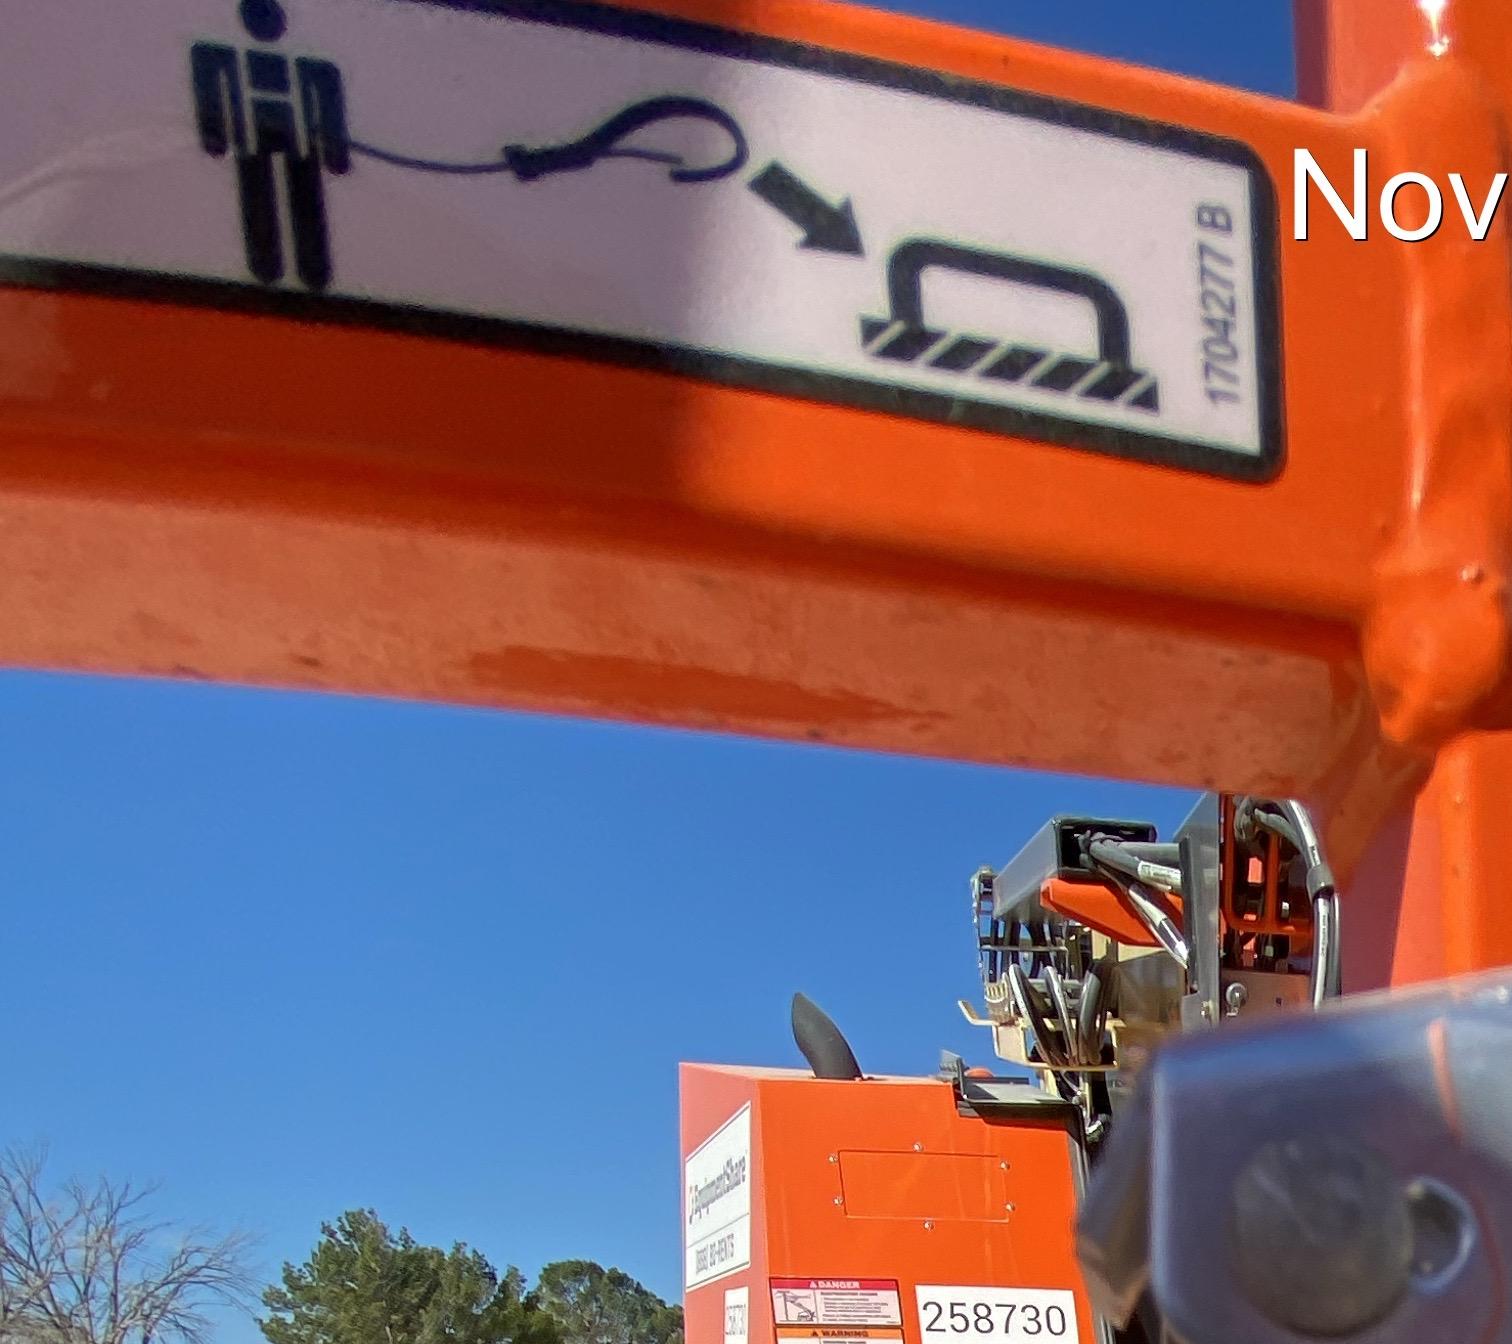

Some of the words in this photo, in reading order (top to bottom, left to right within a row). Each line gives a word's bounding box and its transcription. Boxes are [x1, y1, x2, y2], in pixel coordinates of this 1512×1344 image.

[1197, 205, 1234, 233] B
[1199, 239, 1241, 404] 1704277
[817, 1280, 861, 1290] DANGER
[922, 1300, 1067, 1337] 258730
[821, 1329, 869, 1338] WARNING
